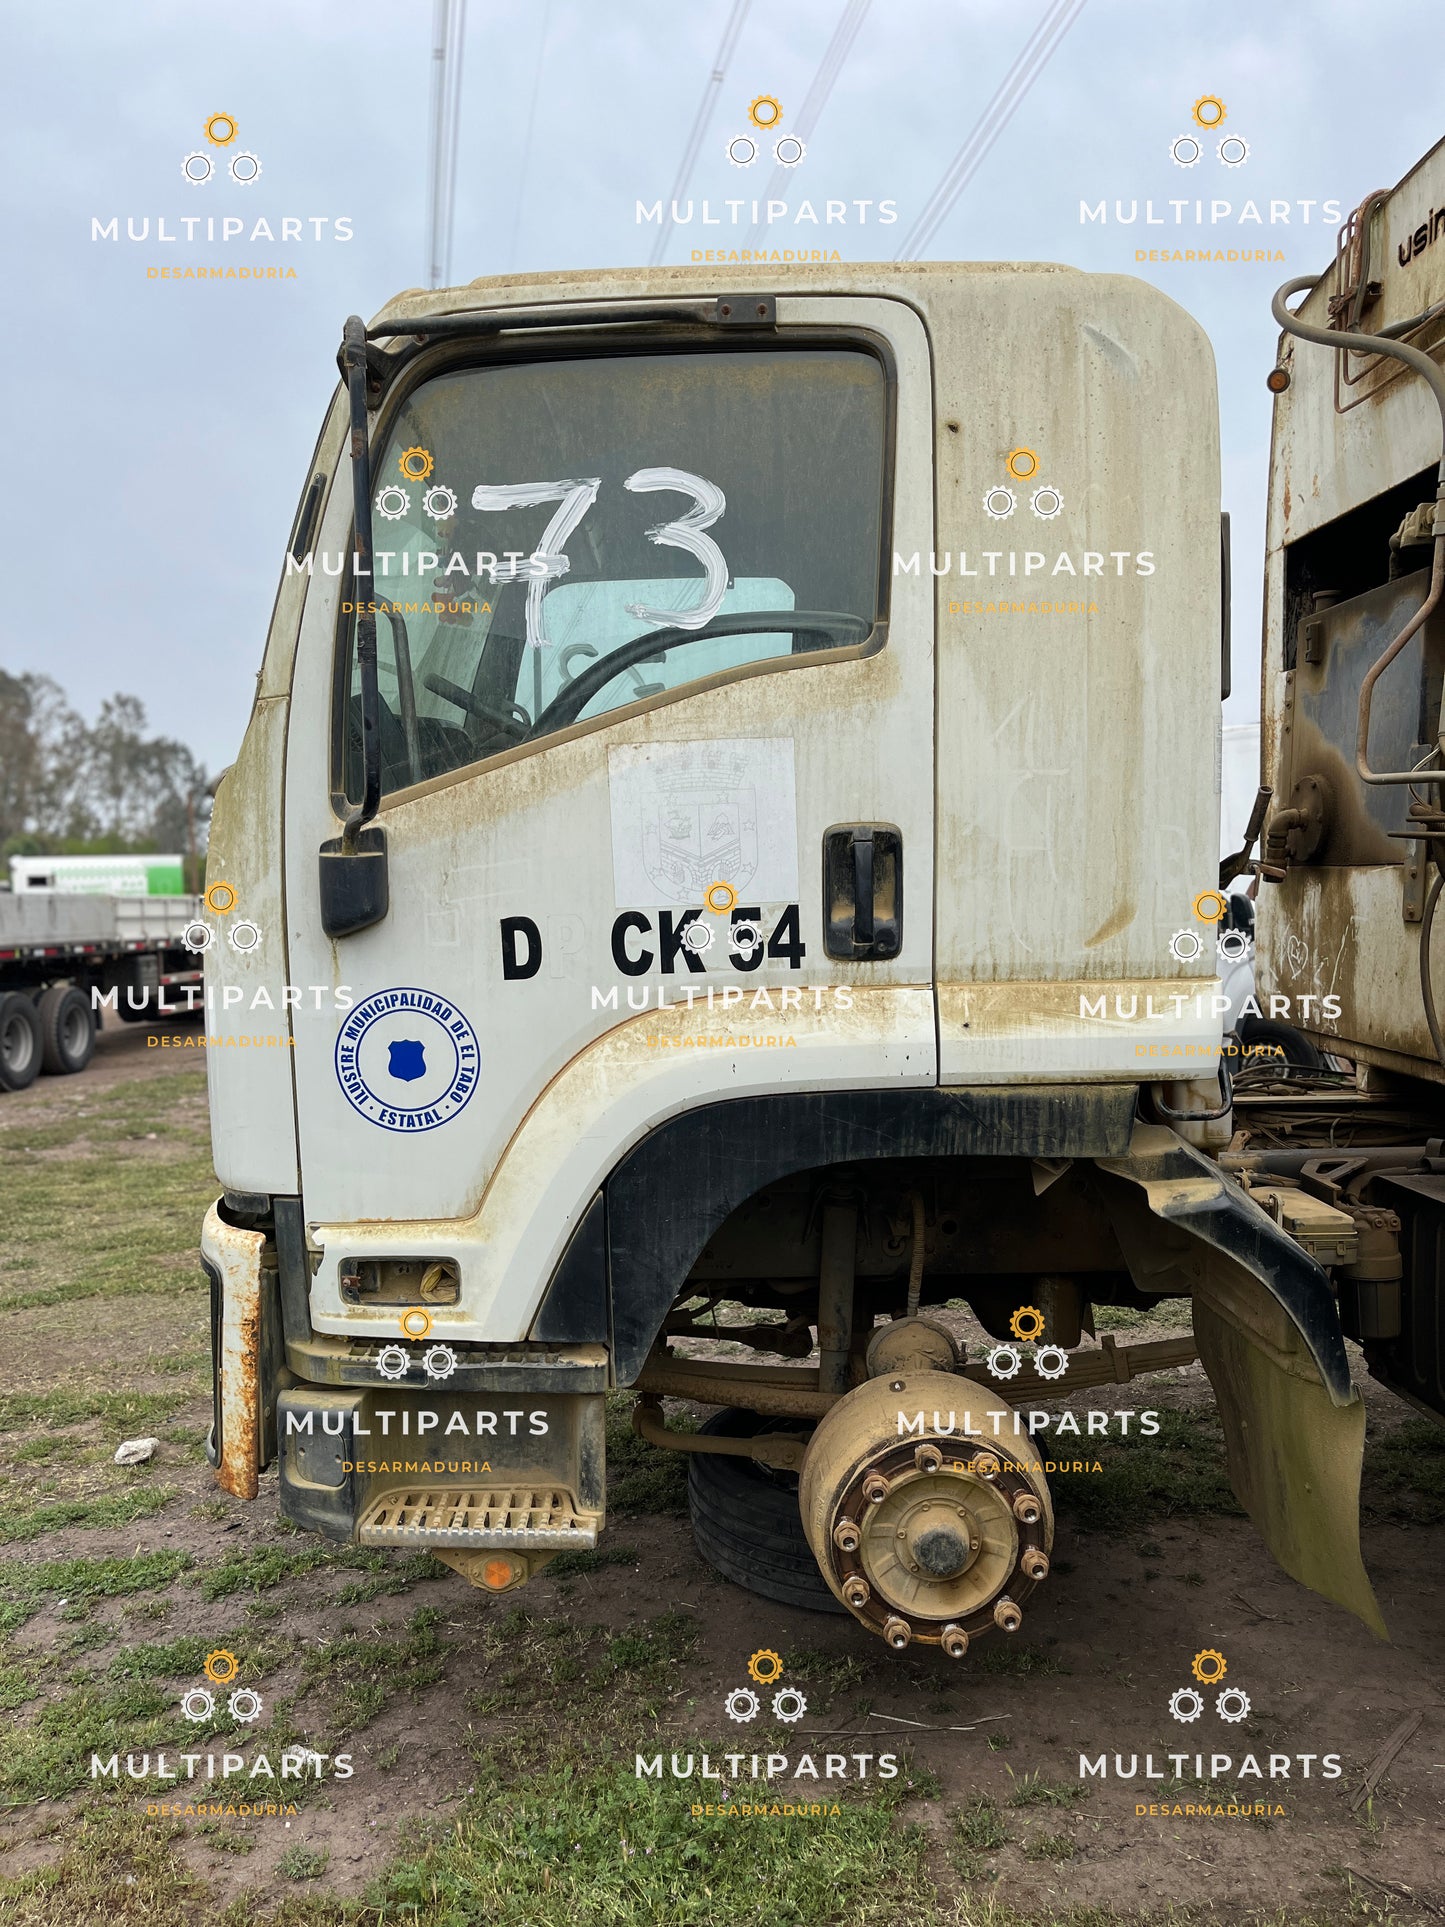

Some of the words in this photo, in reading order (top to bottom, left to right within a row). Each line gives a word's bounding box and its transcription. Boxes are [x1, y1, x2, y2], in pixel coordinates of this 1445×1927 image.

[472, 467, 729, 648] 73
[345, 993, 453, 1041] MUNICIPALIDAD
[450, 1020, 469, 1041] DE
[461, 1045, 475, 1060] EL
[341, 1045, 369, 1105] ILUSTRE
[450, 1066, 475, 1103] TABO
[379, 1109, 442, 1127] ESTATAL
